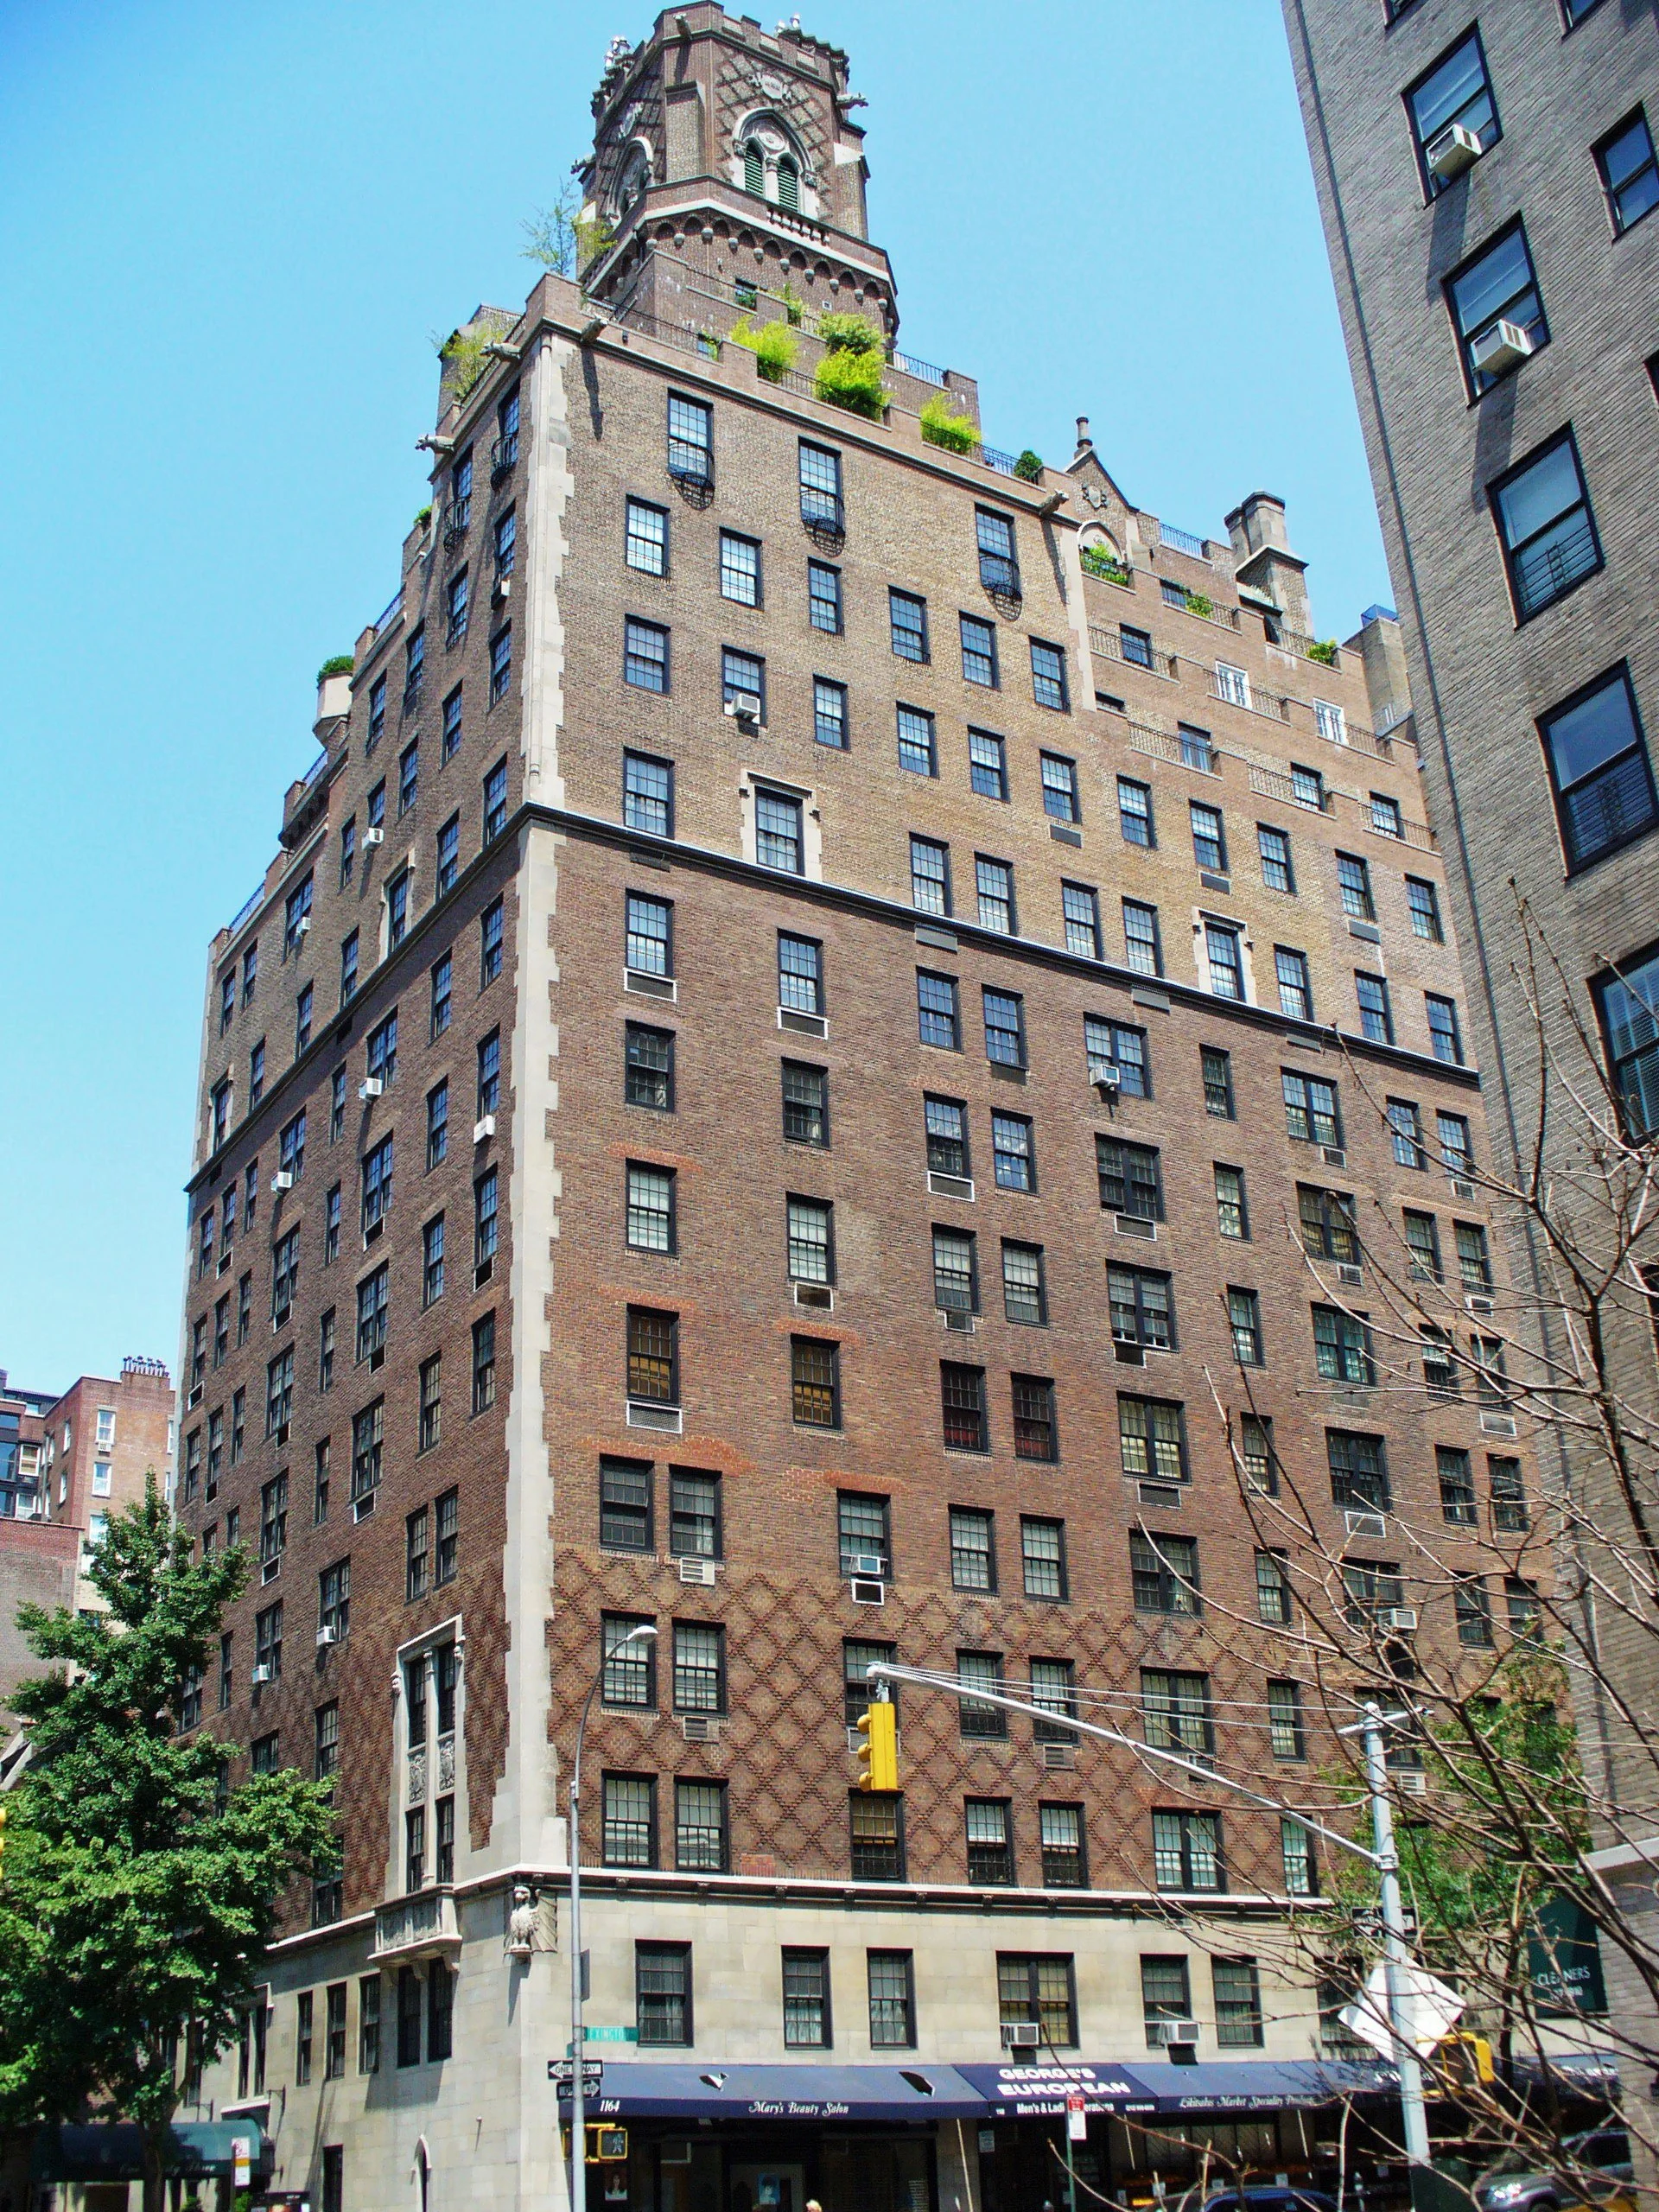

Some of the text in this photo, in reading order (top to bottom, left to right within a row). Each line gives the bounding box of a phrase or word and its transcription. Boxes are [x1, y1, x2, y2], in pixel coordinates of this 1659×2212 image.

[1537, 1966, 1590, 1986] CLENERS
[1000, 2068, 1096, 2080] GEORGE'S
[996, 2082, 1132, 2096] EUROPEAN
[600, 2100, 620, 2112] 1164
[748, 2101, 849, 2117] Mary's Beauty Salon
[1016, 2103, 1040, 2114] Men's
[1040, 2102, 1047, 2113] &
[1047, 2102, 1065, 2113] Ladi
[1084, 2102, 1115, 2113] erations
